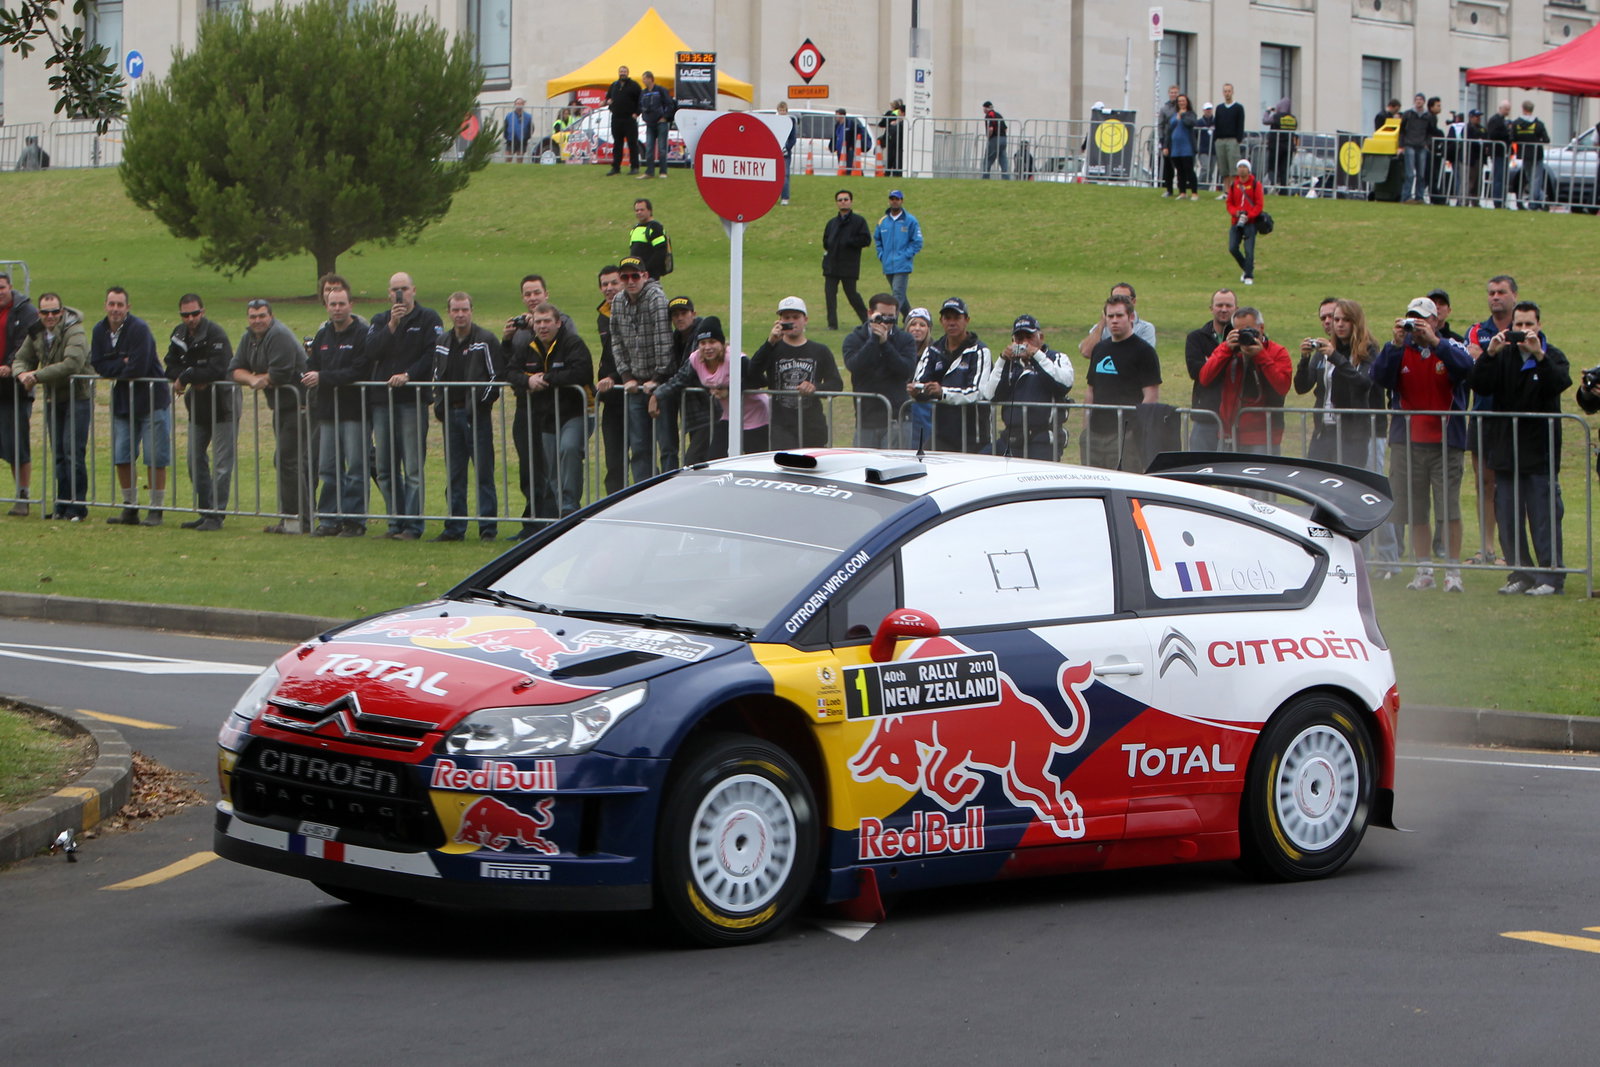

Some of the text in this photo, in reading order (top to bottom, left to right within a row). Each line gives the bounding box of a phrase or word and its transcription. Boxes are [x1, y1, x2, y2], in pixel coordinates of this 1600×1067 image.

[803, 55, 813, 67] 10
[712, 159, 766, 177] NO ENTRY
[779, 361, 792, 372] JACK
[1212, 560, 1276, 592] Loeb
[785, 550, 871, 634] CITROEN-WRC.COM
[616, 641, 697, 659] ZEALAND
[315, 653, 449, 697] TOTAL
[883, 660, 993, 683] 40th RALLY 2010
[855, 669, 870, 717] 1
[884, 677, 997, 708] NEW ZEALAND
[826, 709, 843, 717] Elena
[1121, 743, 1236, 778] TOTAL
[481, 861, 551, 881] PIRELLI
